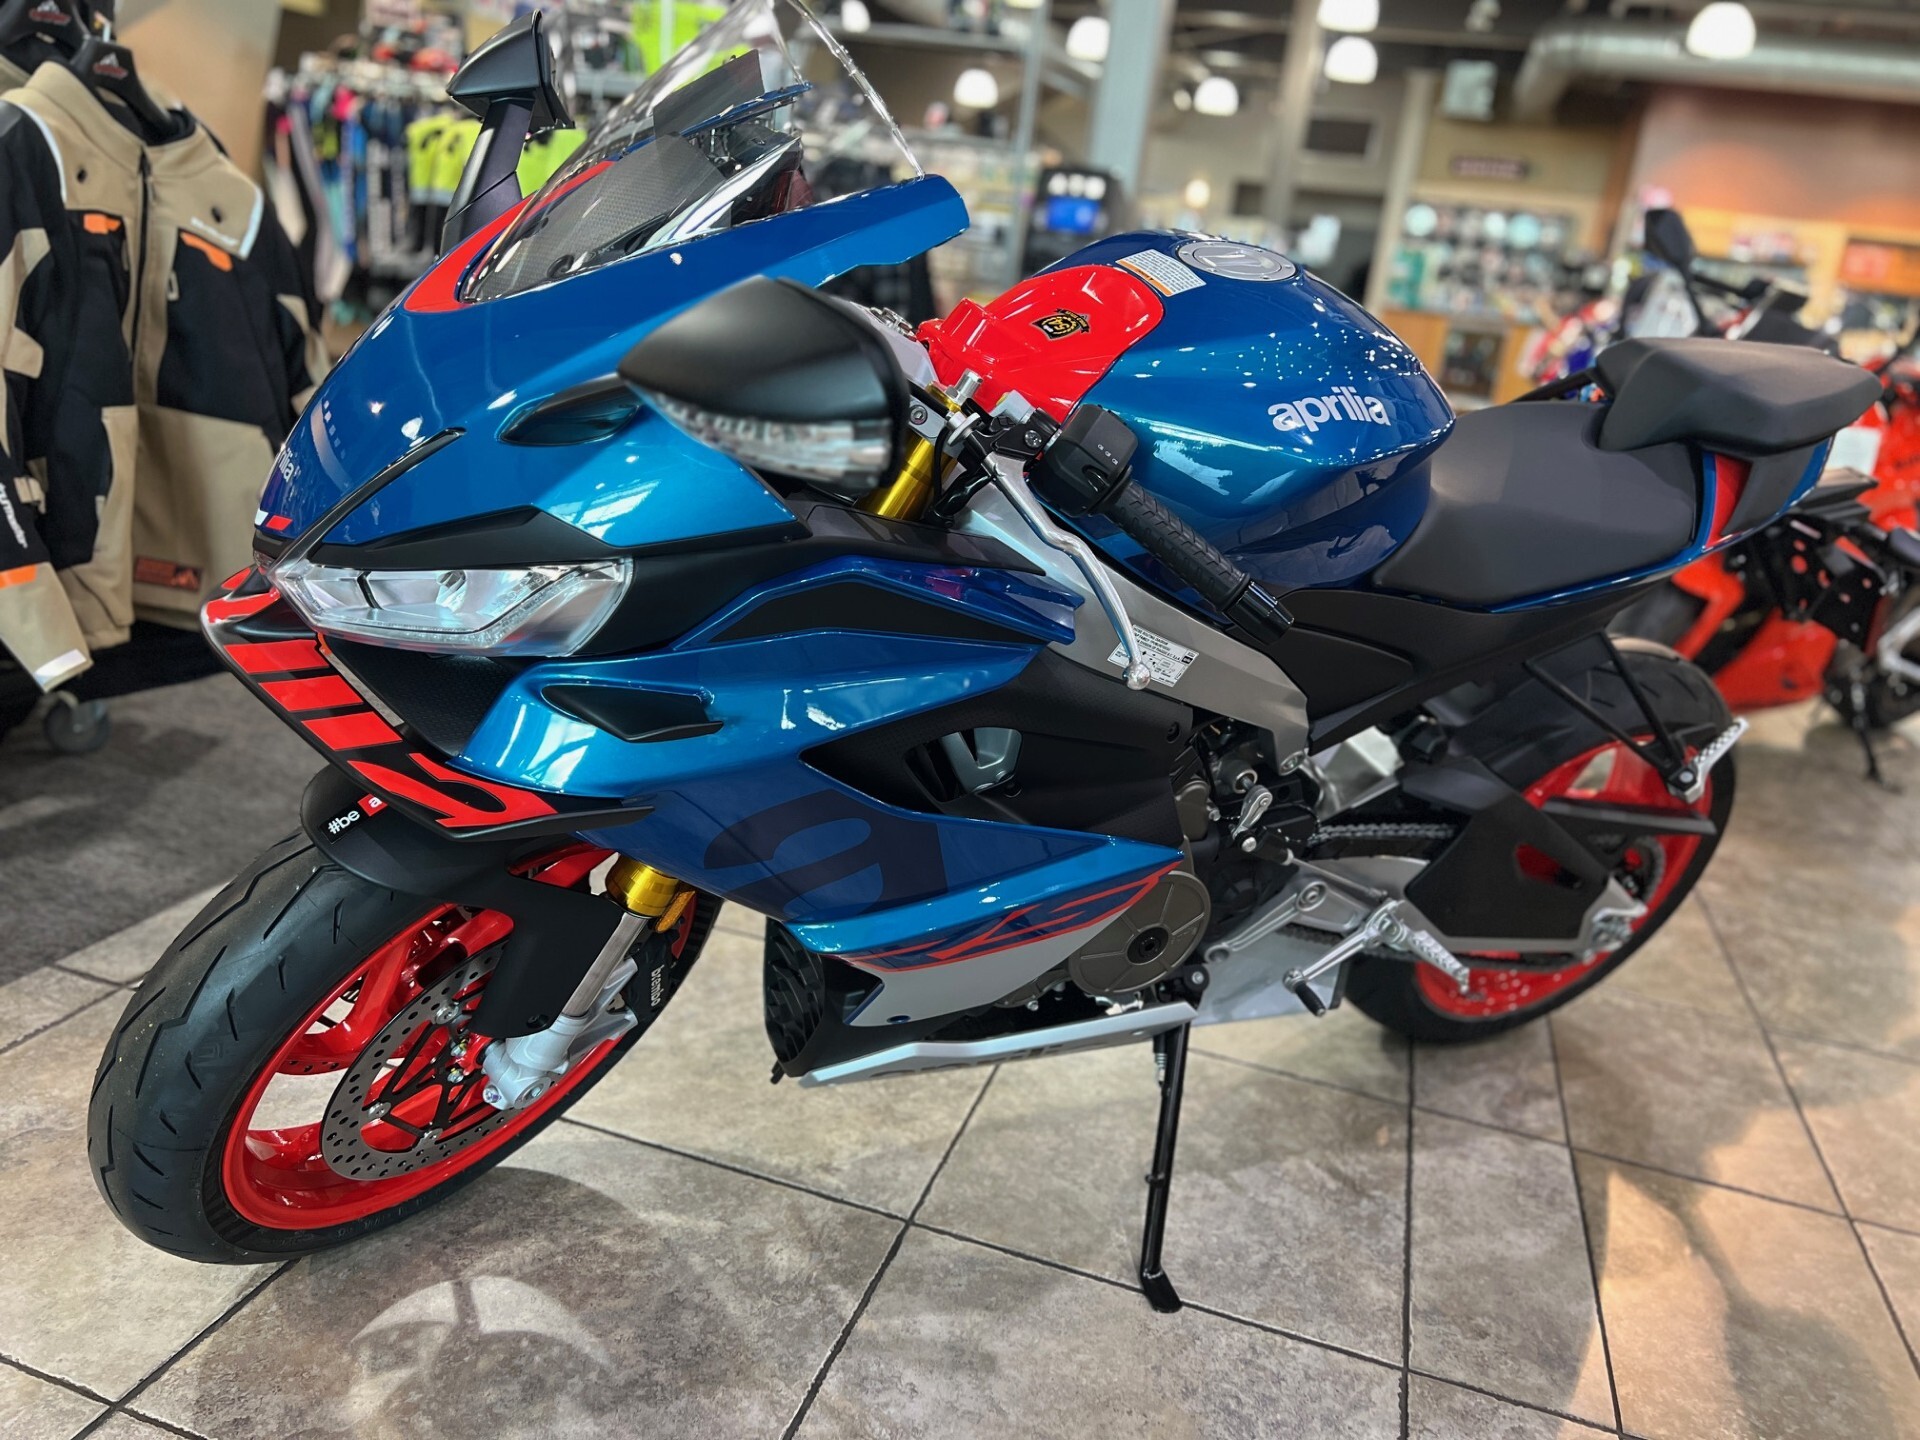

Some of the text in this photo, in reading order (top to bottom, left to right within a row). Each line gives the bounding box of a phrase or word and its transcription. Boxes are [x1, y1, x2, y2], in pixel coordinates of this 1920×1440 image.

[1267, 386, 1392, 432] aprilia
[328, 797, 383, 834] #be a
[651, 964, 665, 1007] brembo
